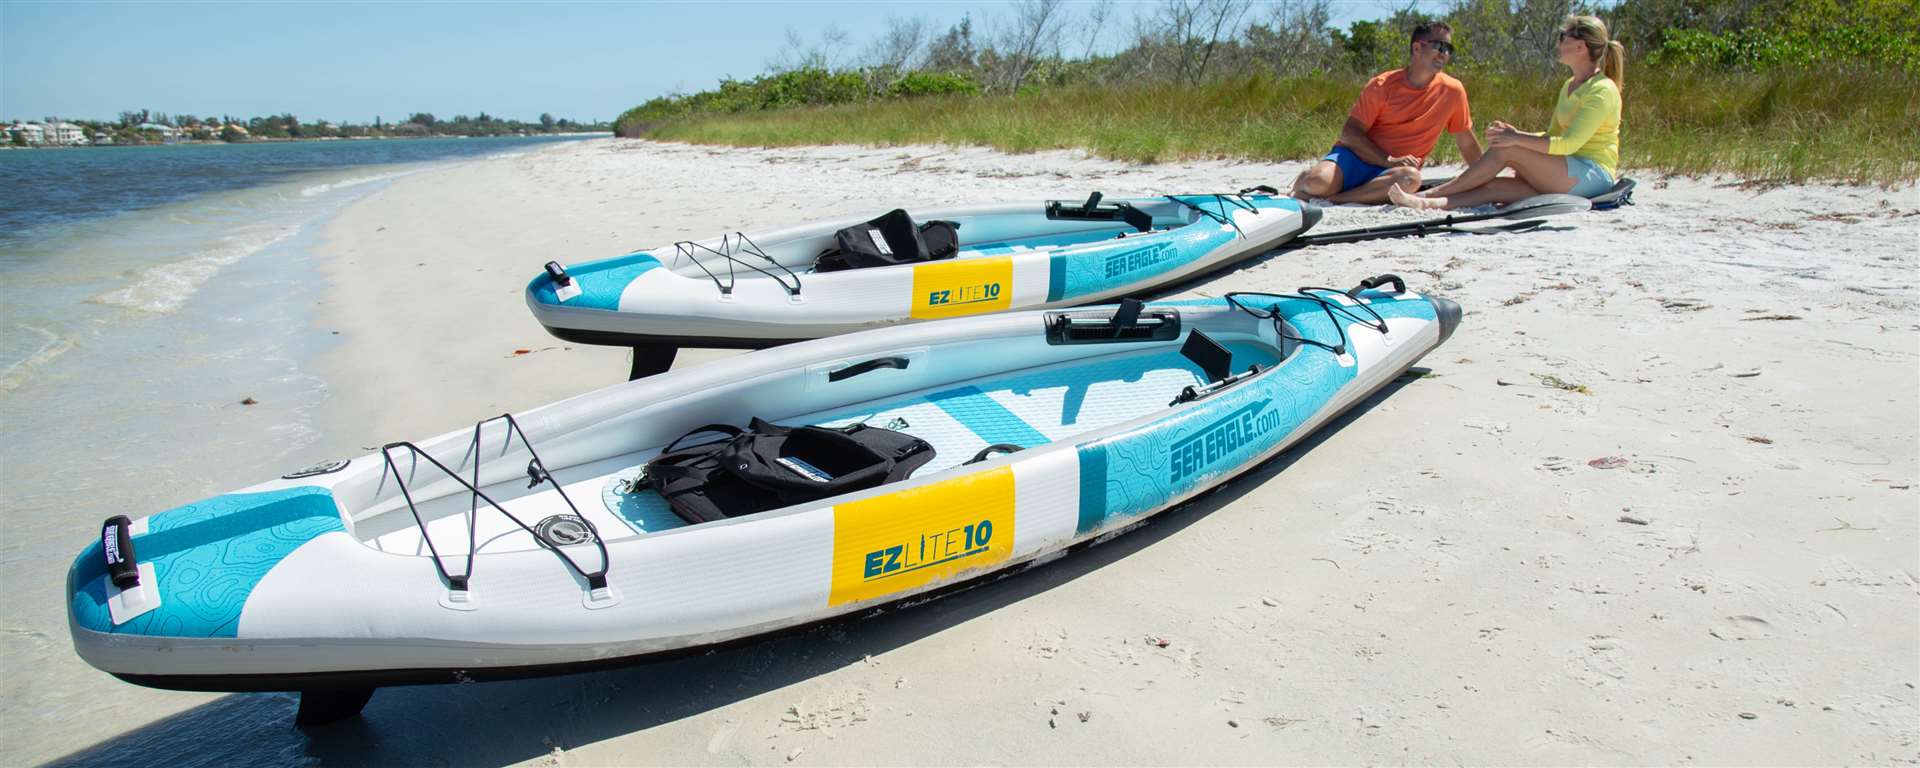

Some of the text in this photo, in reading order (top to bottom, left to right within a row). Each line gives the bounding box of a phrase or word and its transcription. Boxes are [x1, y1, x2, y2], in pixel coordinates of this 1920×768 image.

[1105, 257, 1127, 280] SEA
[1170, 408, 1280, 484] SEA EAGLE.com
